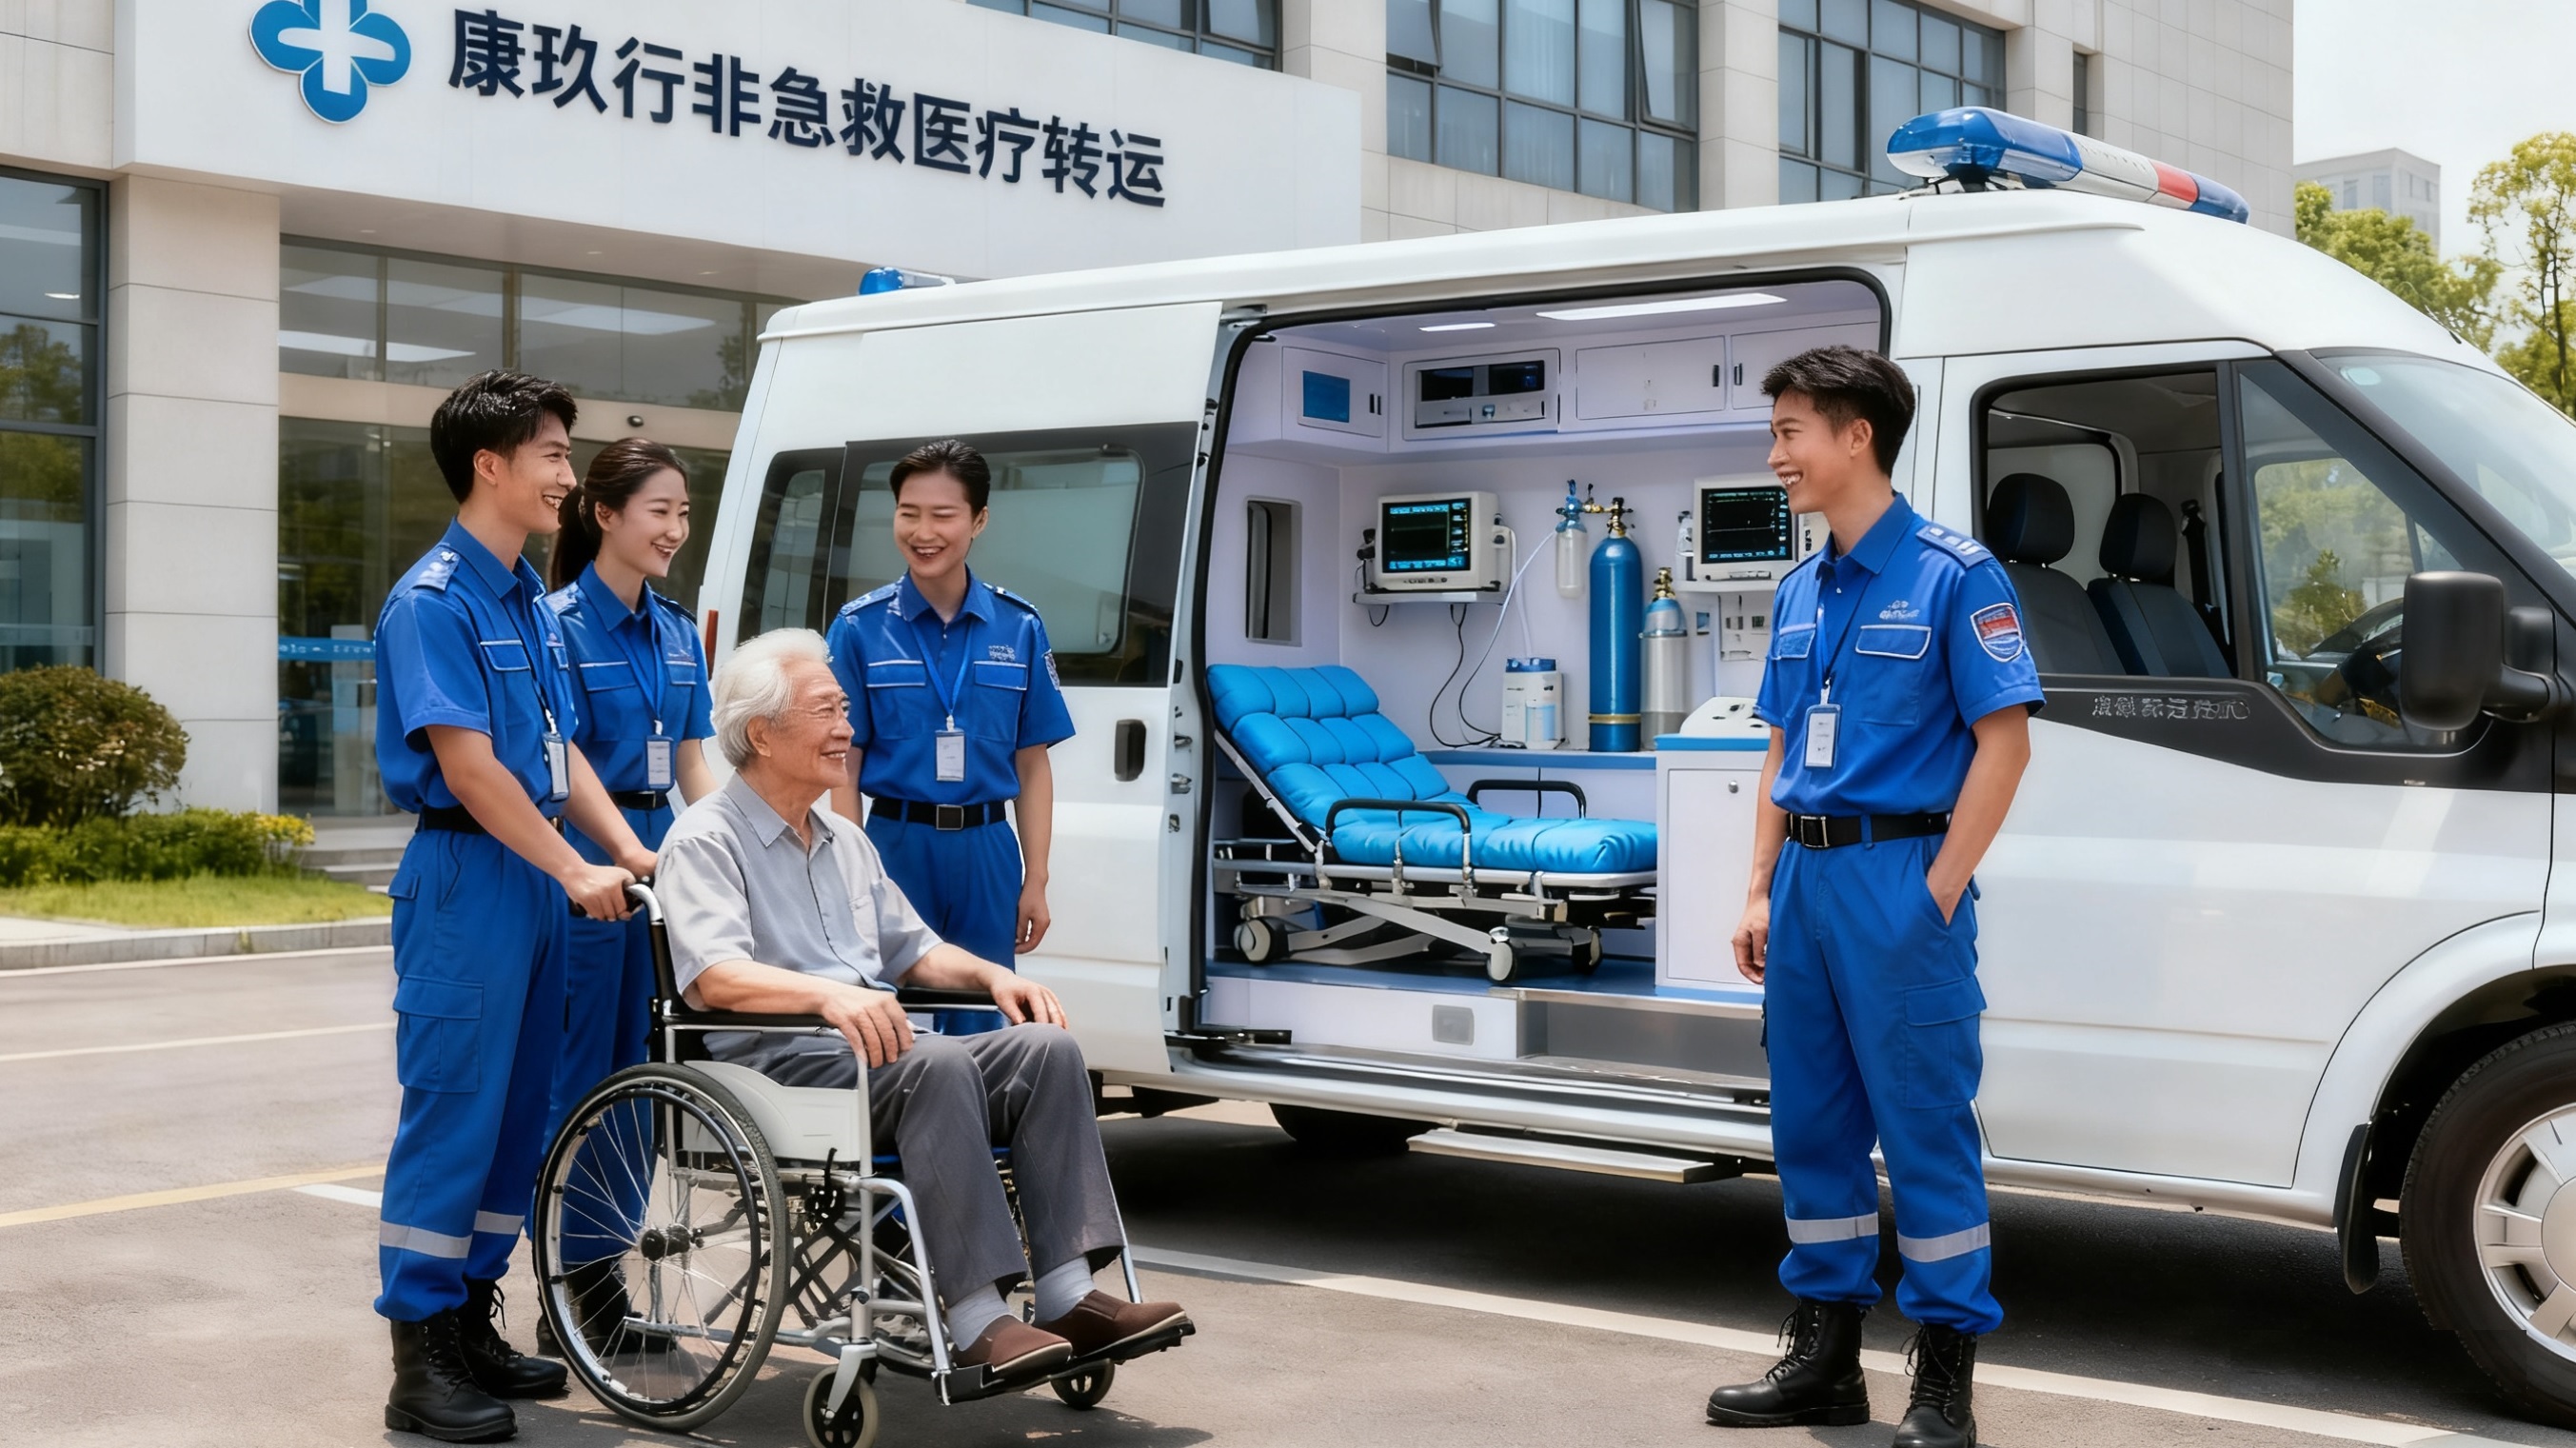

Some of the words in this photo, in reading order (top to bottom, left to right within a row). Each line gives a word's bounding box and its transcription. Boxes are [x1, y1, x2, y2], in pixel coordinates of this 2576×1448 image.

[448, 9, 1166, 208] 康玖行非急救医疗转运
